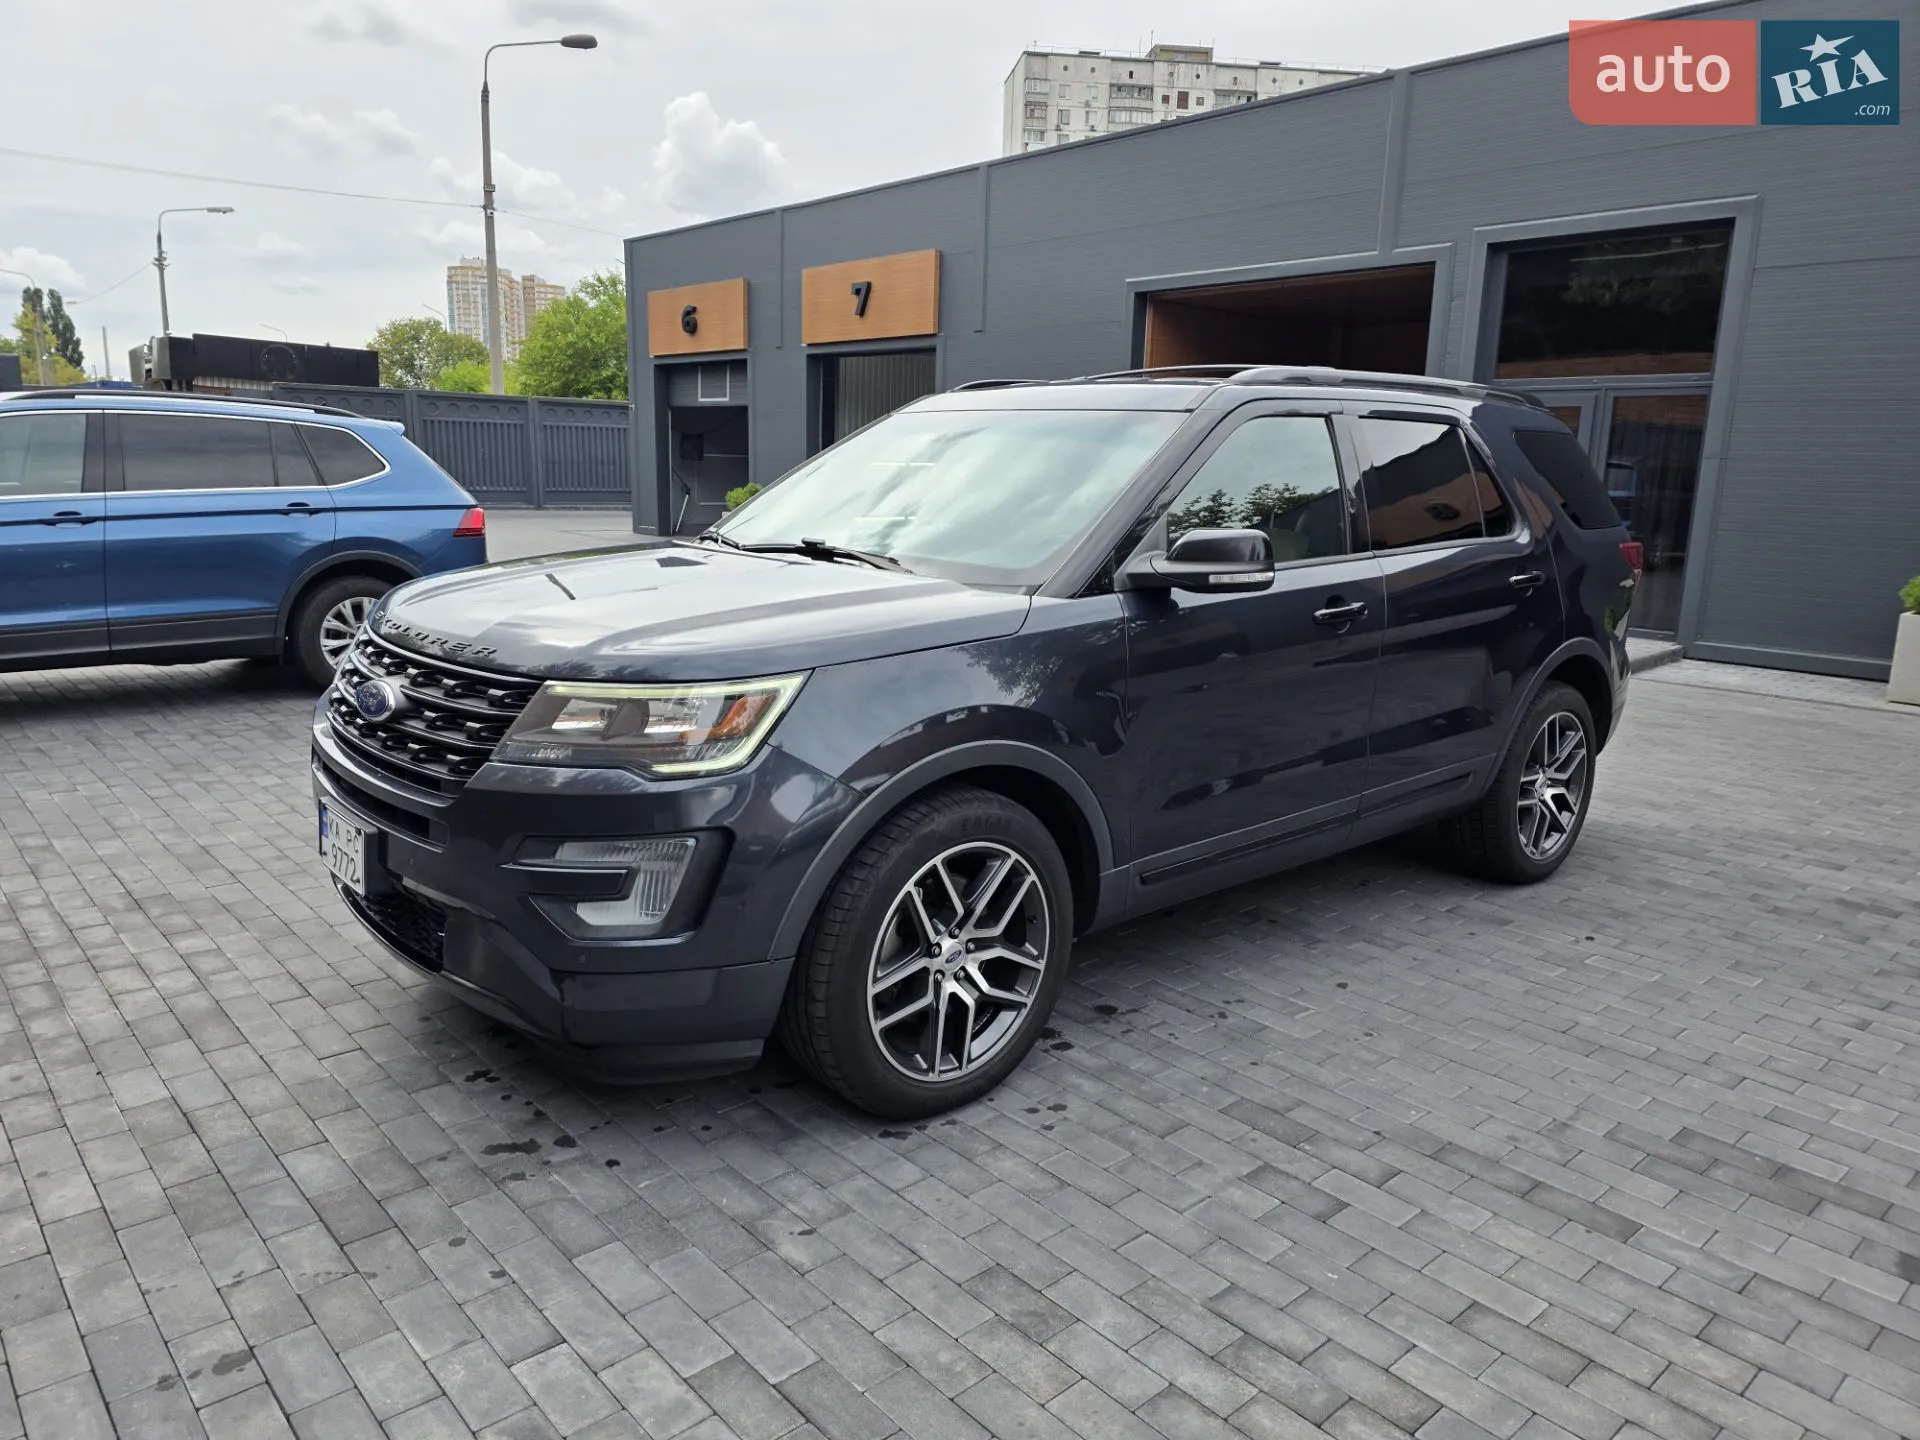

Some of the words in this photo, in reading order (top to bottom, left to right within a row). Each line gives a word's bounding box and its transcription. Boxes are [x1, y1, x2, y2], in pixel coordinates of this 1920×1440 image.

[851, 281, 872, 317] 7
[681, 304, 698, 335] 6
[331, 842, 357, 885] 9772
